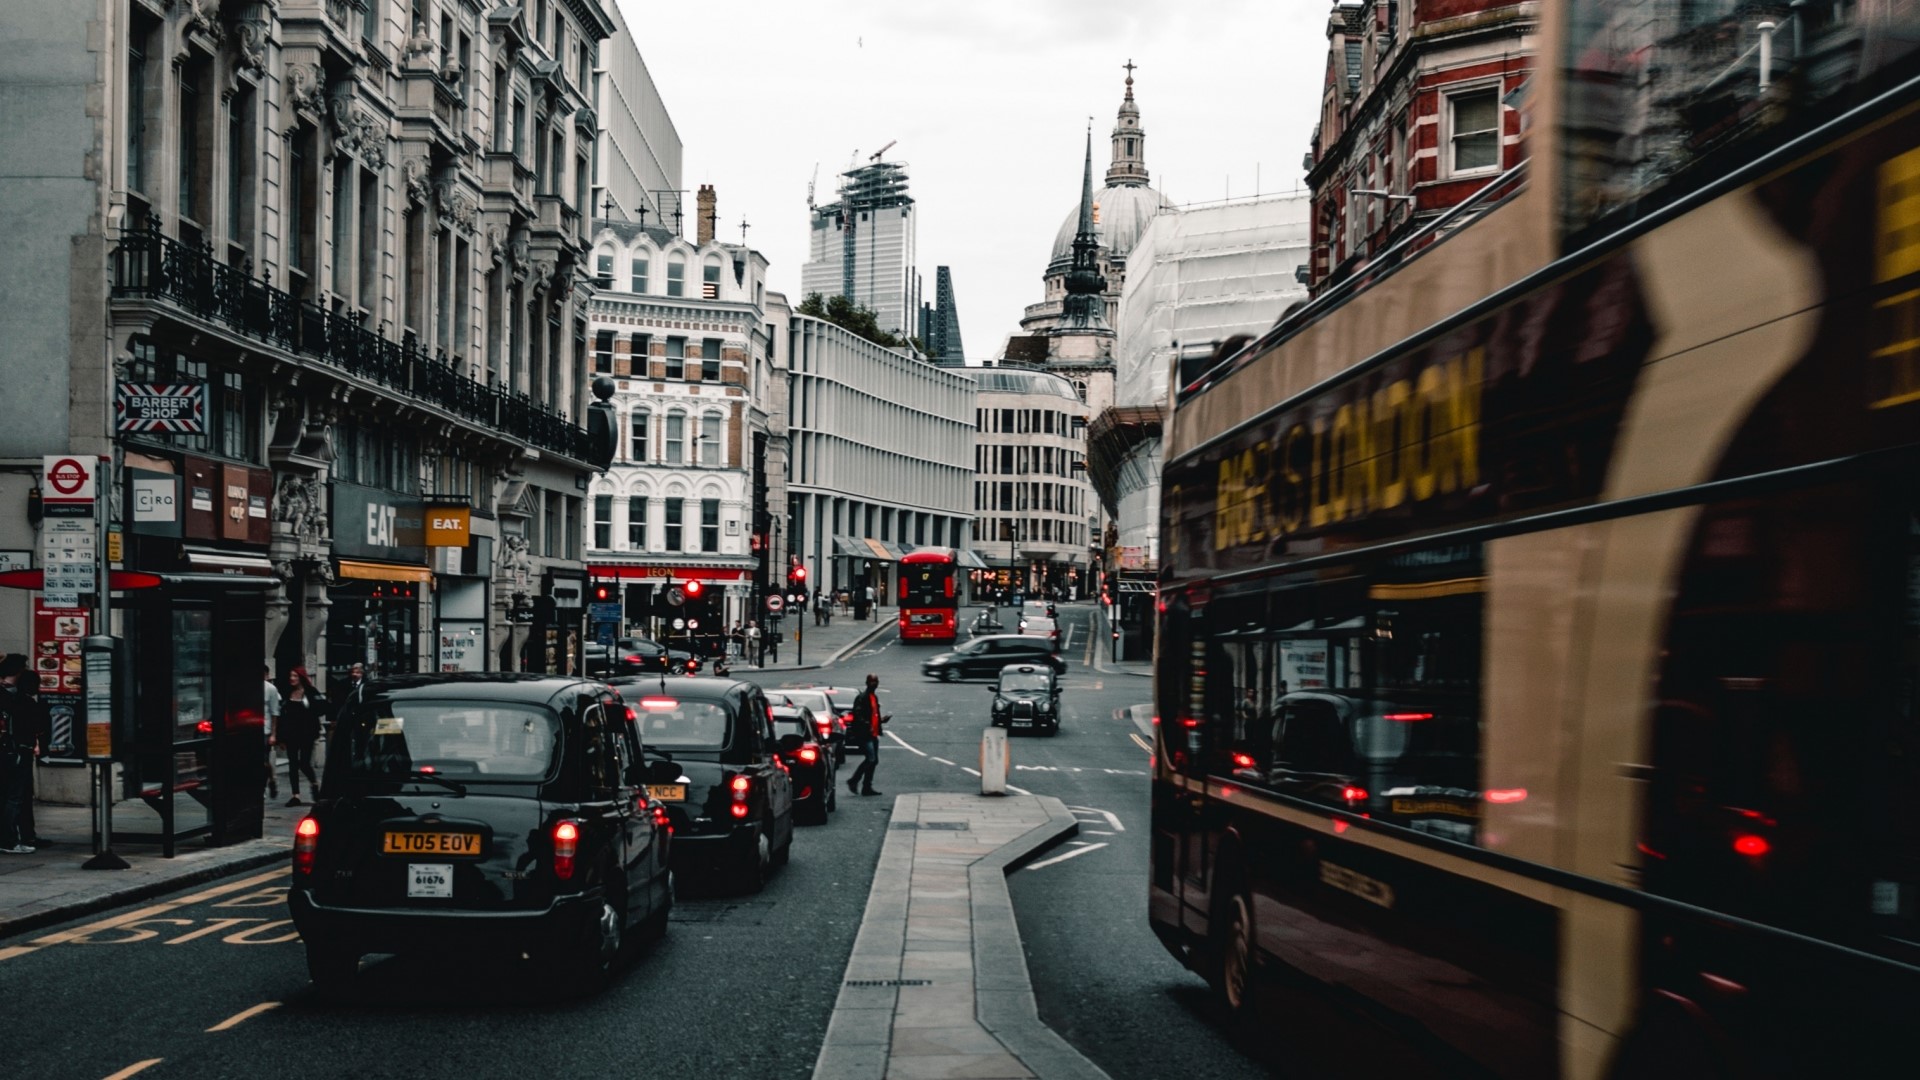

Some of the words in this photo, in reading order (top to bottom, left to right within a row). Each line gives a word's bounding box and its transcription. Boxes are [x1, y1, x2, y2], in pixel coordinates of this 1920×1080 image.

[131, 397, 189, 409] BARBER
[141, 407, 180, 419] SHOP
[140, 496, 173, 505] CIRQ
[367, 502, 398, 548] EAT.
[432, 518, 463, 530] EAT.
[647, 567, 675, 577] LEON
[655, 786, 677, 797] NCC
[391, 834, 435, 850] LT05
[440, 835, 473, 851] EOV
[415, 875, 445, 885] 61676
[69, 917, 303, 945] STO
